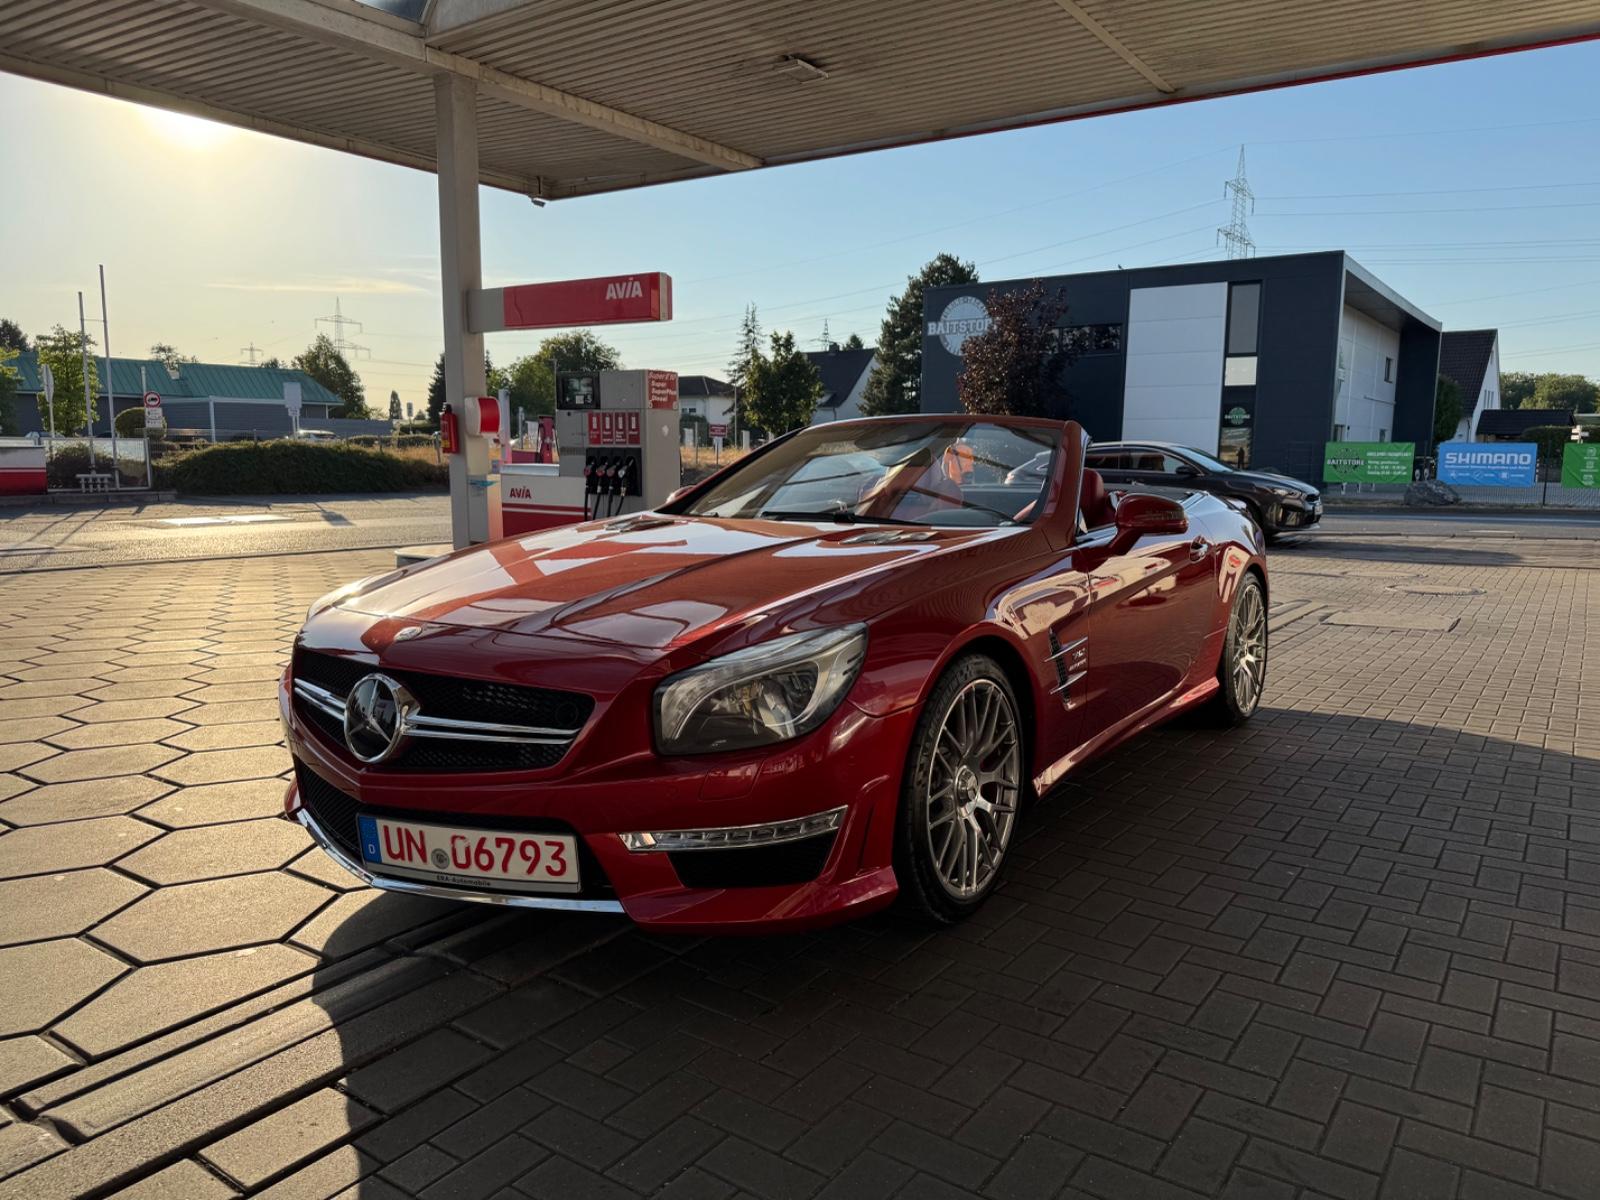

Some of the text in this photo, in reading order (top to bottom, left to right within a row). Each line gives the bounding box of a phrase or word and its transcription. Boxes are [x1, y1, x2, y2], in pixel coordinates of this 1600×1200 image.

[605, 277, 643, 300] AVIA
[1445, 452, 1531, 465] SHIMANO
[509, 485, 532, 499] AVIA
[368, 844, 376, 855] D
[383, 825, 567, 877] UN 06793
